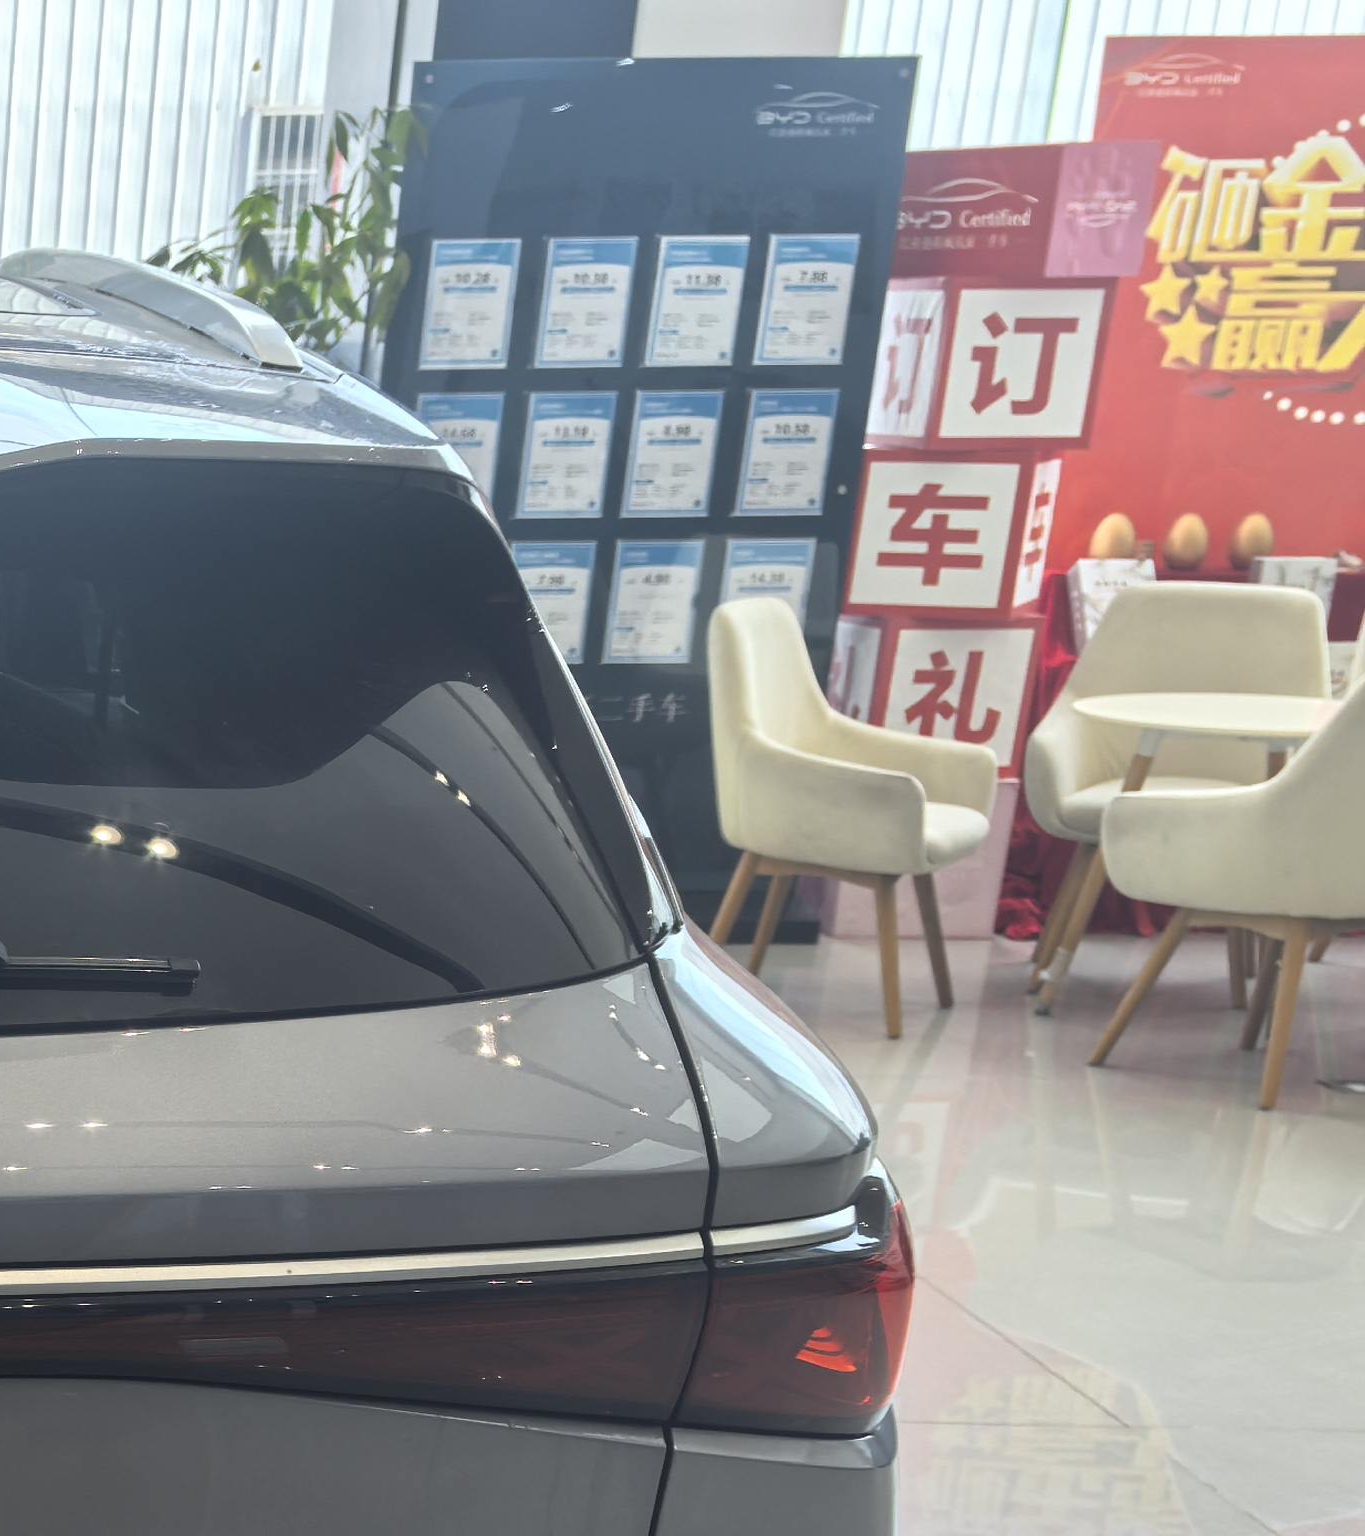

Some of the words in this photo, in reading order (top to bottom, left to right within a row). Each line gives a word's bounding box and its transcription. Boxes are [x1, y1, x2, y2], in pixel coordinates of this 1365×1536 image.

[756, 110, 812, 125] BYD
[959, 206, 1031, 229] Certified
[970, 311, 1080, 416] 订
[876, 483, 991, 587] 车
[585, 692, 688, 723] 二手车
[904, 650, 1002, 745] 礼
